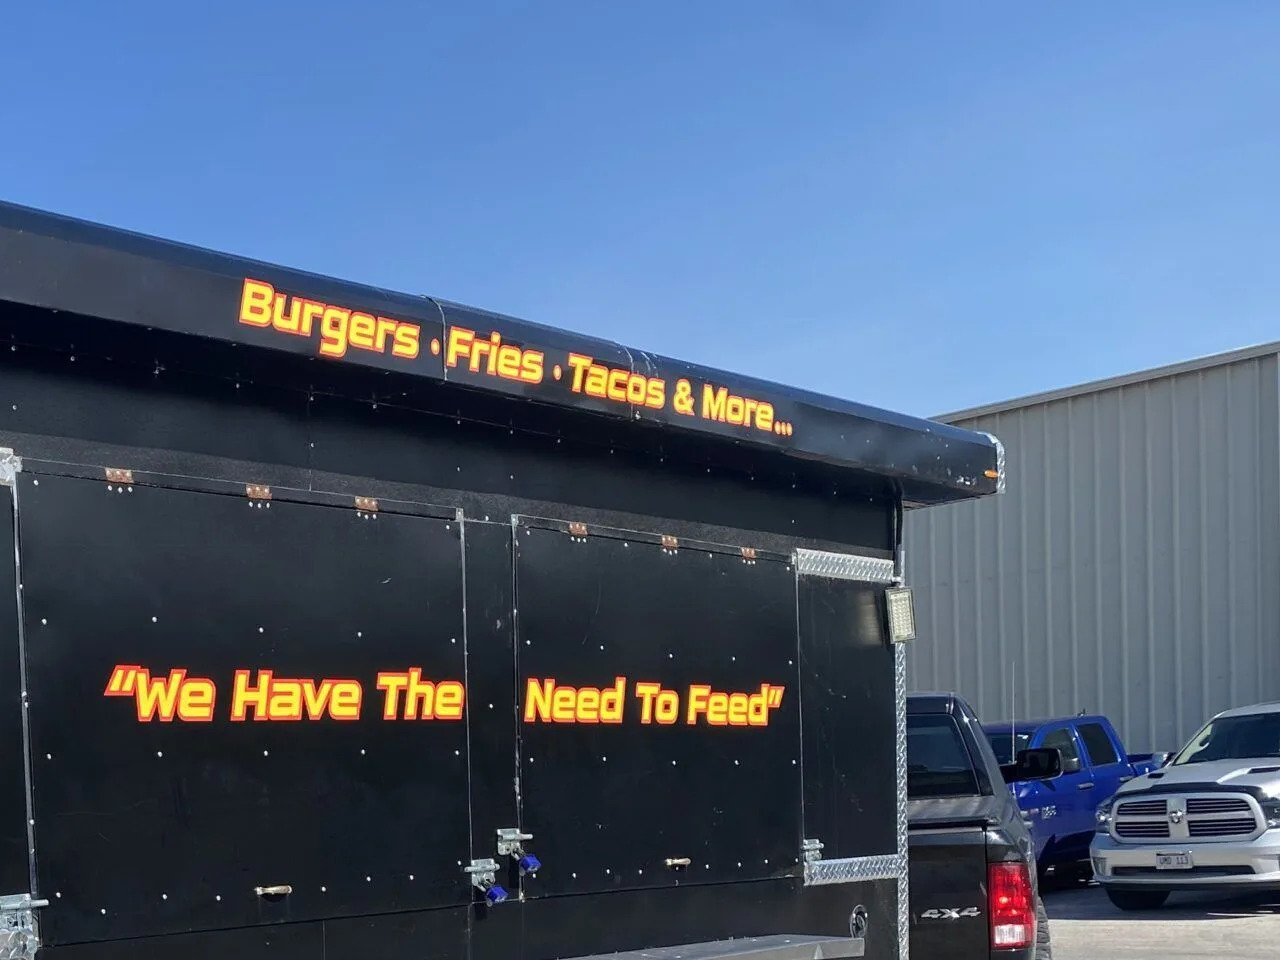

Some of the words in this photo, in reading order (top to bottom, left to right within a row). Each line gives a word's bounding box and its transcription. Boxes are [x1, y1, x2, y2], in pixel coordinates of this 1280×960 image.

[238, 277, 421, 358] Burgers
[446, 325, 544, 384] Fries
[568, 352, 666, 409] Tacos
[673, 378, 695, 416] &
[230, 669, 362, 721] Have
[376, 667, 465, 721] The
[523, 676, 627, 724] Need
[635, 682, 679, 725] To
